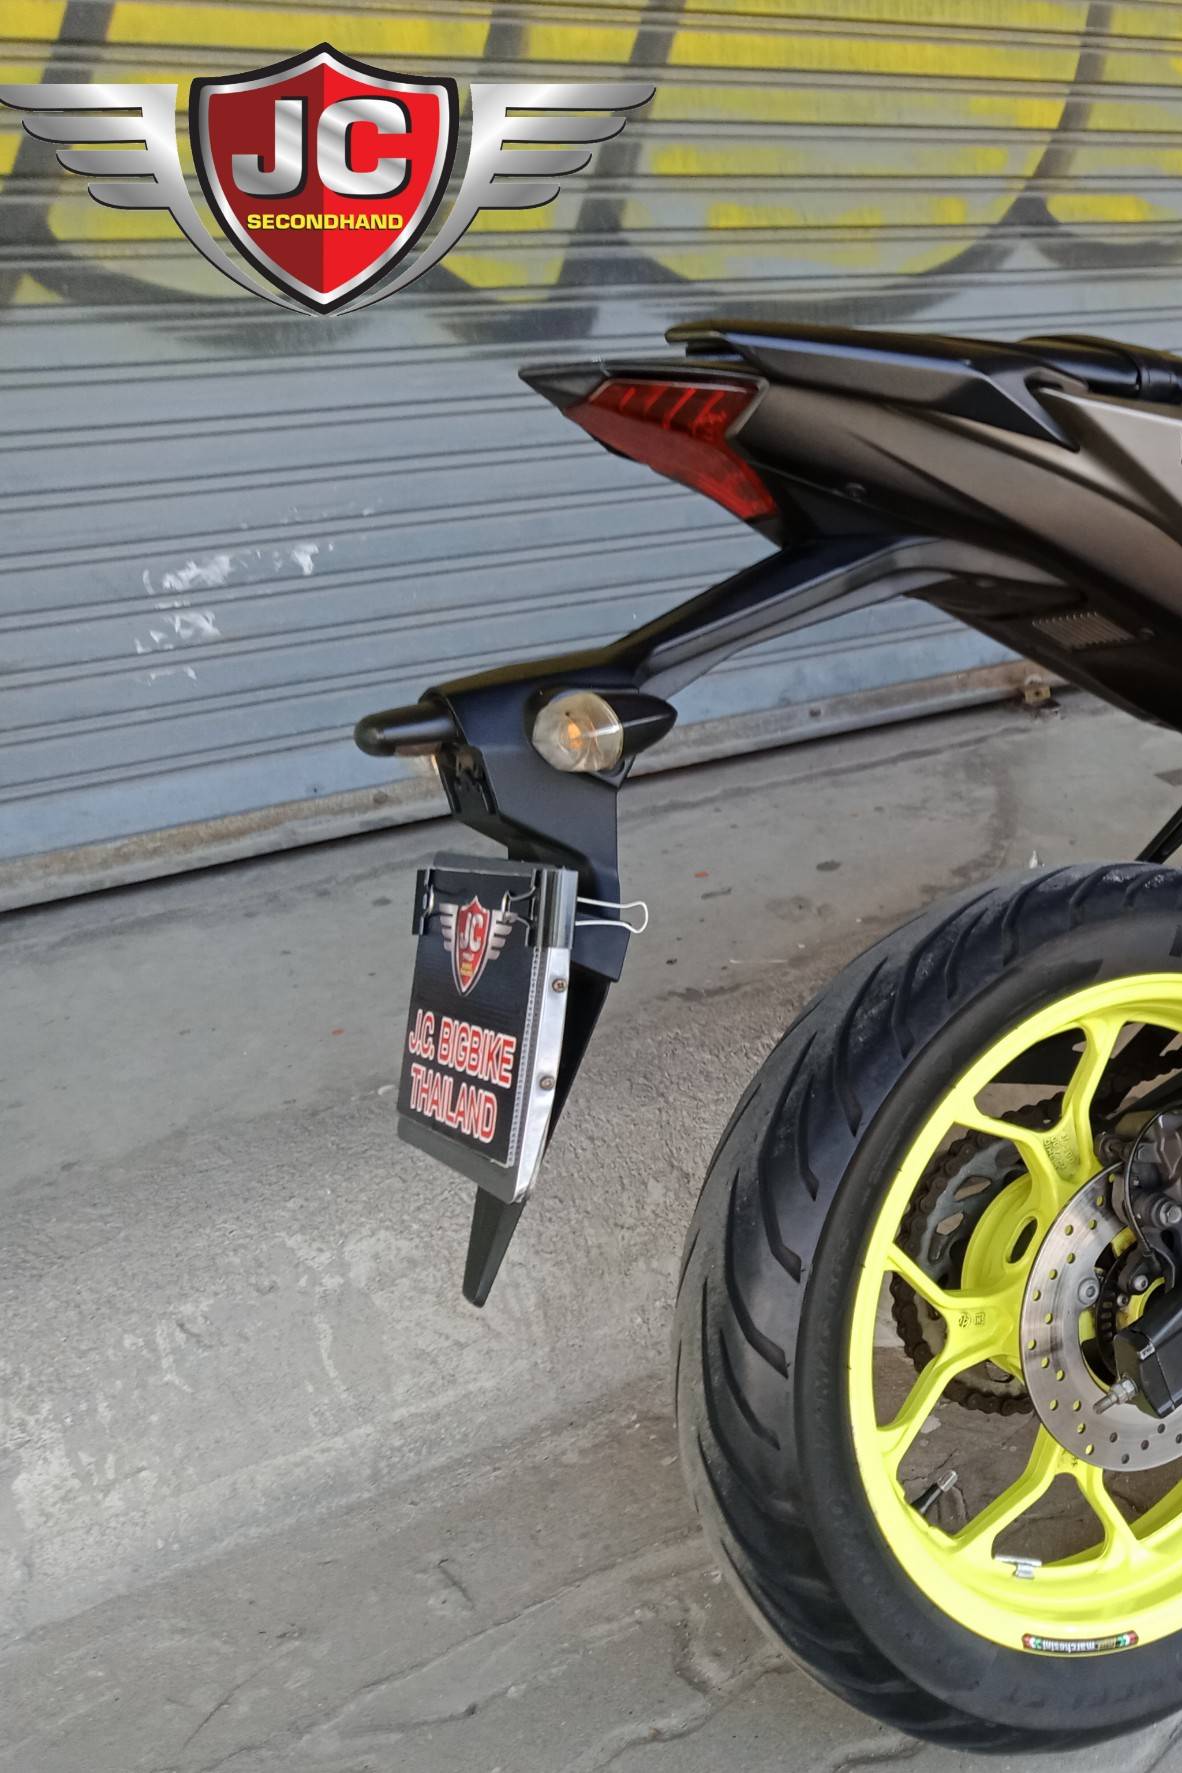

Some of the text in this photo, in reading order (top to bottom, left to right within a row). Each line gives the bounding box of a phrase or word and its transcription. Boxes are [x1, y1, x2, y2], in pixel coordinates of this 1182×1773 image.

[459, 911, 484, 953] JC
[437, 1015, 517, 1090] BIGBIKE
[409, 1062, 498, 1144] THAILAND
